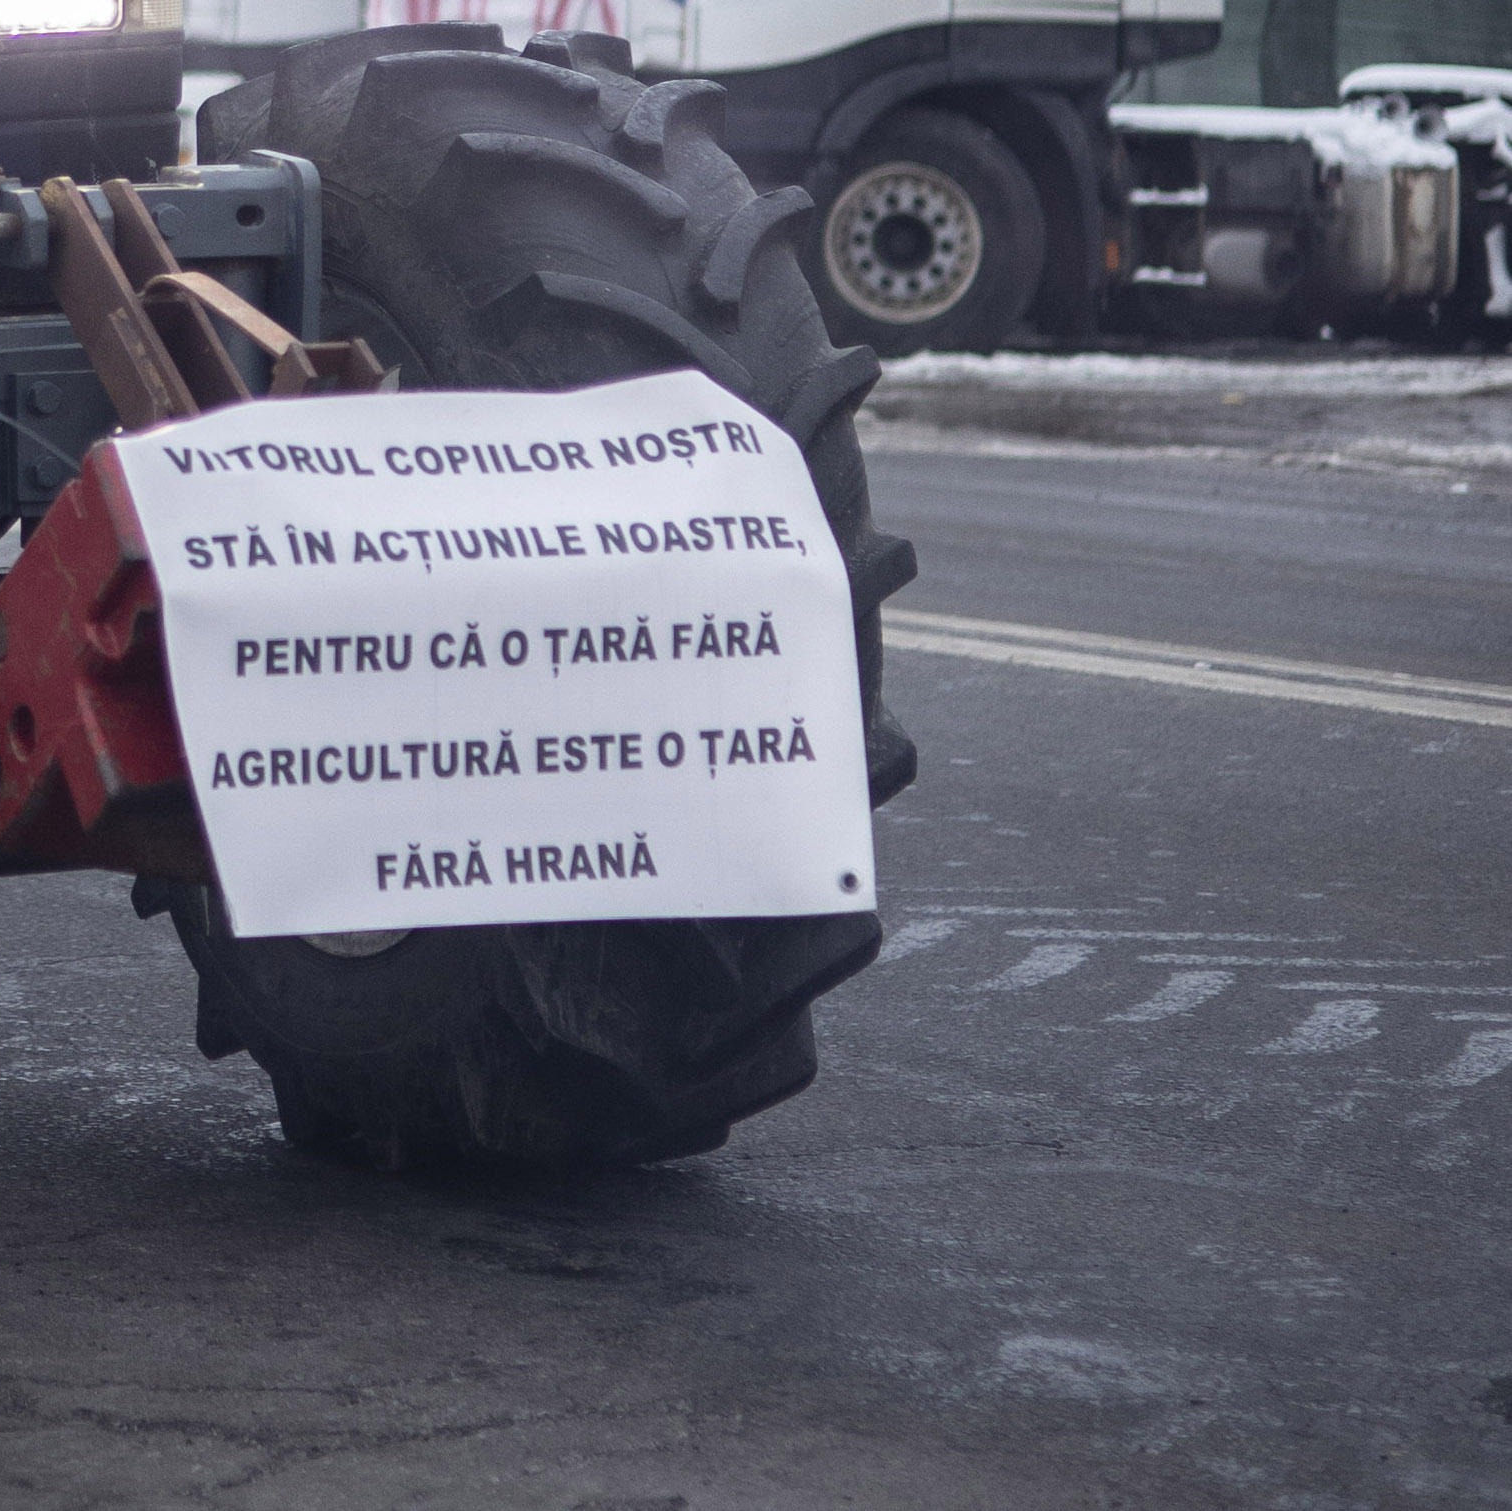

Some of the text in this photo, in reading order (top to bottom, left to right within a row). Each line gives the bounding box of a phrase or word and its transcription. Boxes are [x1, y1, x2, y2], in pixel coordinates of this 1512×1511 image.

[162, 420, 764, 476] VIITORUL COPIILOR NOȘTRI
[184, 516, 808, 574] STĂ ÎN ACȚIUNILE NOASTRE,
[236, 611, 781, 678] PENTRU CĂ O ȚARĂ FĂRĂ
[212, 717, 816, 789] AGRICULTURĂ ESTE O ȚARĂ
[376, 832, 658, 891] FĂRĂ HRANĂ
